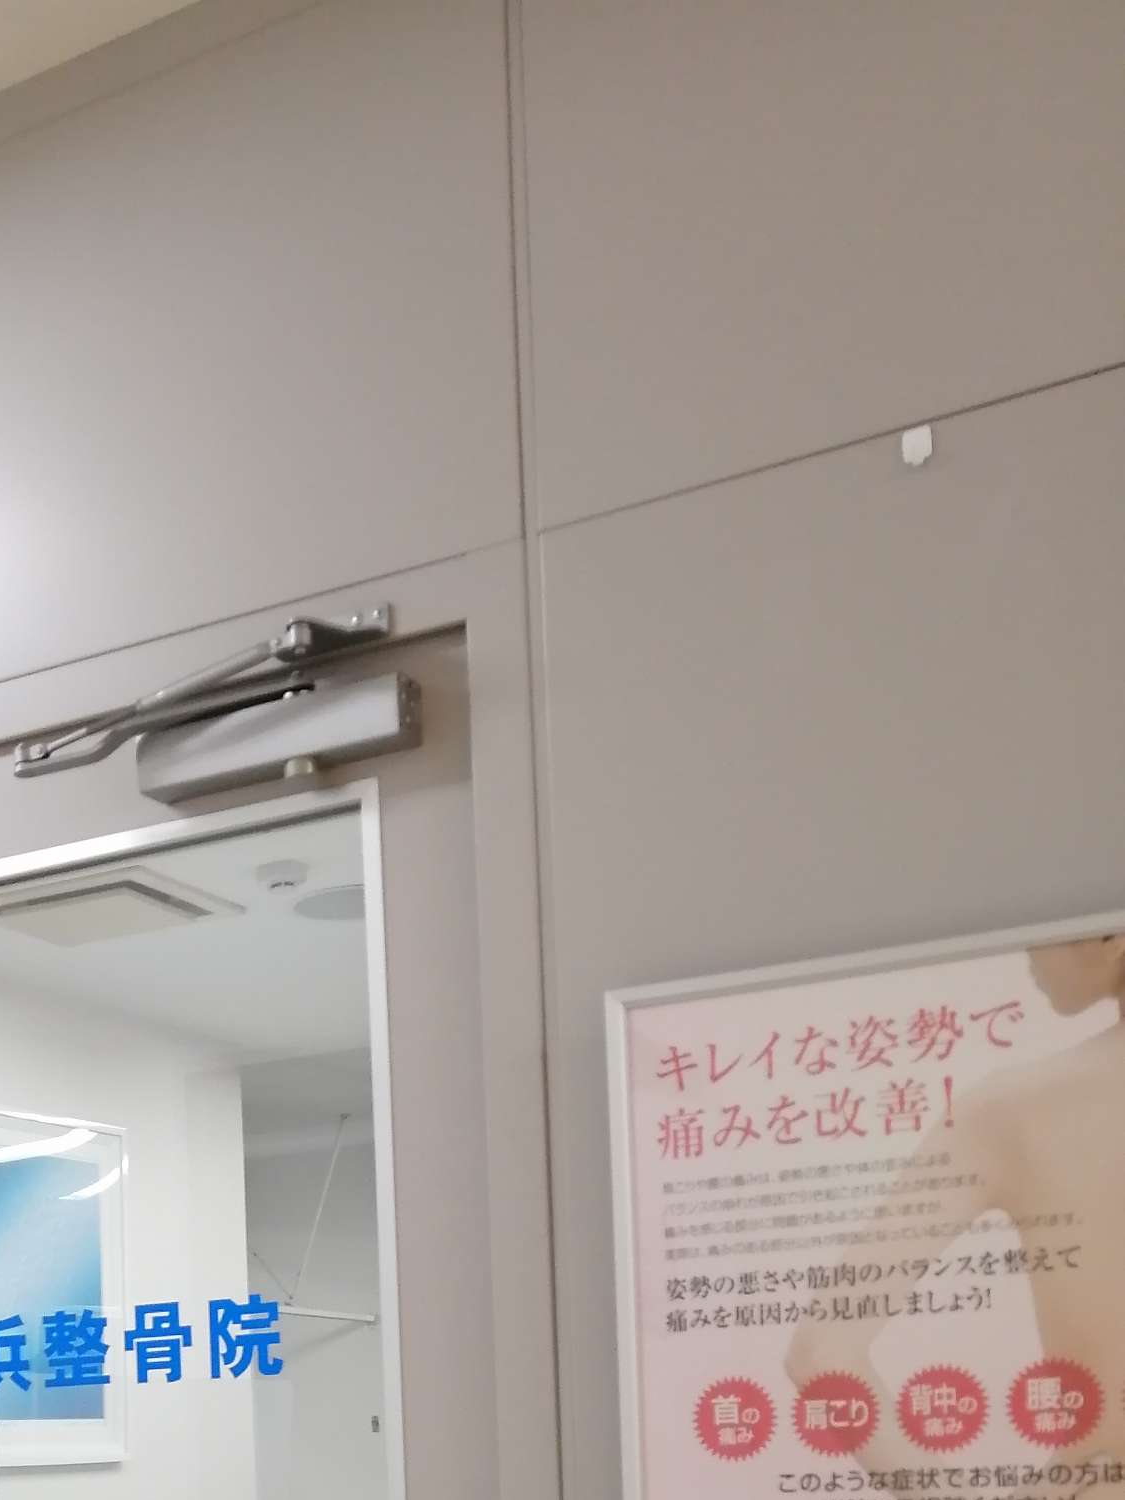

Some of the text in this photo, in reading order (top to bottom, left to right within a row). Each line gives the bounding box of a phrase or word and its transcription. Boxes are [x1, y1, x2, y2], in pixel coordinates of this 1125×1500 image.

[656, 1001, 1025, 1092] キレイな姿勢で
[666, 1245, 1081, 1301] 姿勢の悪さや筋肉のバランスを整えて
[712, 1394, 761, 1426] 首の
[909, 1382, 978, 1417] 背中の
[1027, 1376, 1085, 1411] 腰の
[804, 1398, 870, 1430] 肩こり
[778, 1463, 1125, 1494] このような症状でお悩みの方は
